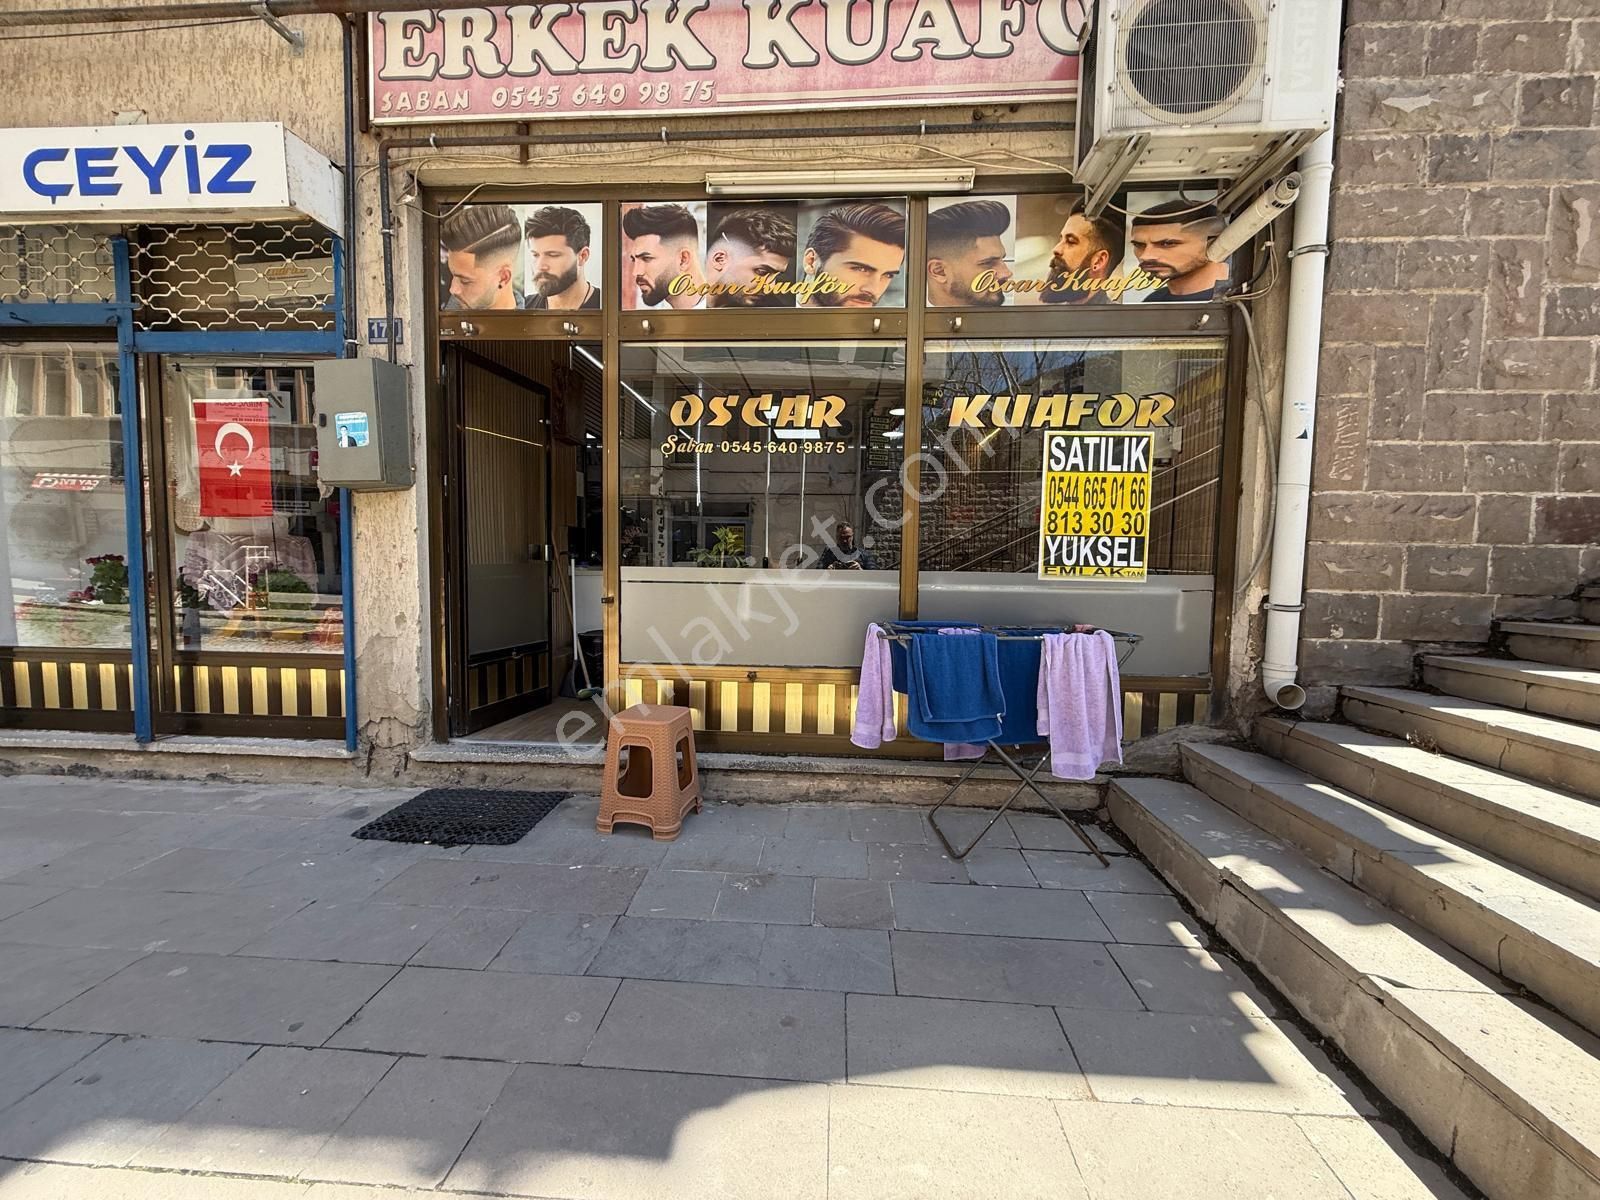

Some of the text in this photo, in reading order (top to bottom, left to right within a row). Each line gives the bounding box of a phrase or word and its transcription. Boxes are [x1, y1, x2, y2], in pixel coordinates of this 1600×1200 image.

[378, 0, 717, 81] ERKEK
[492, 86, 561, 108] 0545
[572, 83, 626, 106] 640
[638, 82, 671, 105] 98
[681, 80, 716, 103] 75
[23, 129, 257, 204] ÇEYİZ
[668, 271, 856, 304] Oscar Kuaför
[970, 267, 1170, 301] Oscar Kuaför
[669, 393, 847, 428] OSCAR
[948, 392, 1176, 428] KUAFOR
[660, 434, 846, 458] Şaban 0545 640 9875
[1050, 436, 1149, 472] SATILIK
[1049, 475, 1146, 510] 0544 665 01 66
[1047, 511, 1145, 535] 813 30 30
[1045, 535, 1143, 567] YÜKSEL
[1044, 566, 1124, 576] EMLAK
